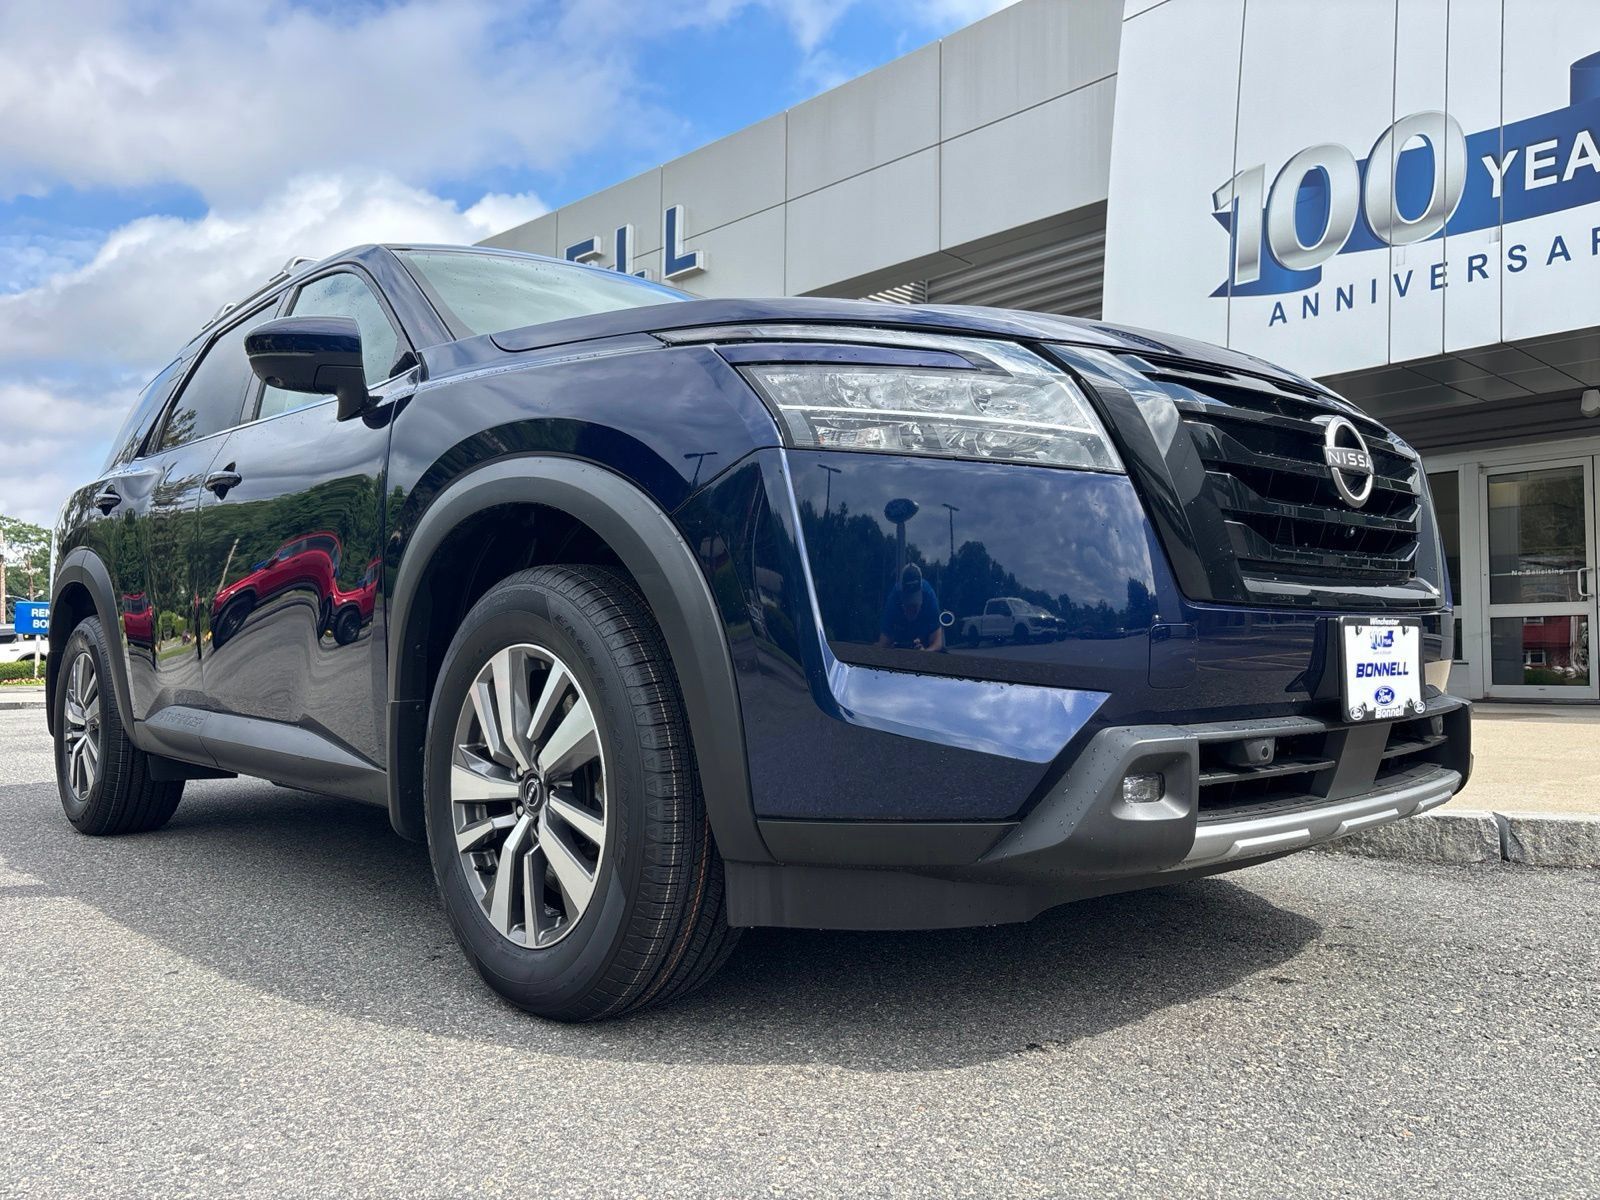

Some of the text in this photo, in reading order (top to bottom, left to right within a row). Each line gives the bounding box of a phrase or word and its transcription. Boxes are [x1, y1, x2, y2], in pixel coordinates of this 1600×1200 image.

[1212, 109, 1468, 286] 100
[1356, 661, 1409, 678] BONNELL
[1375, 705, 1405, 719] Bonnell
